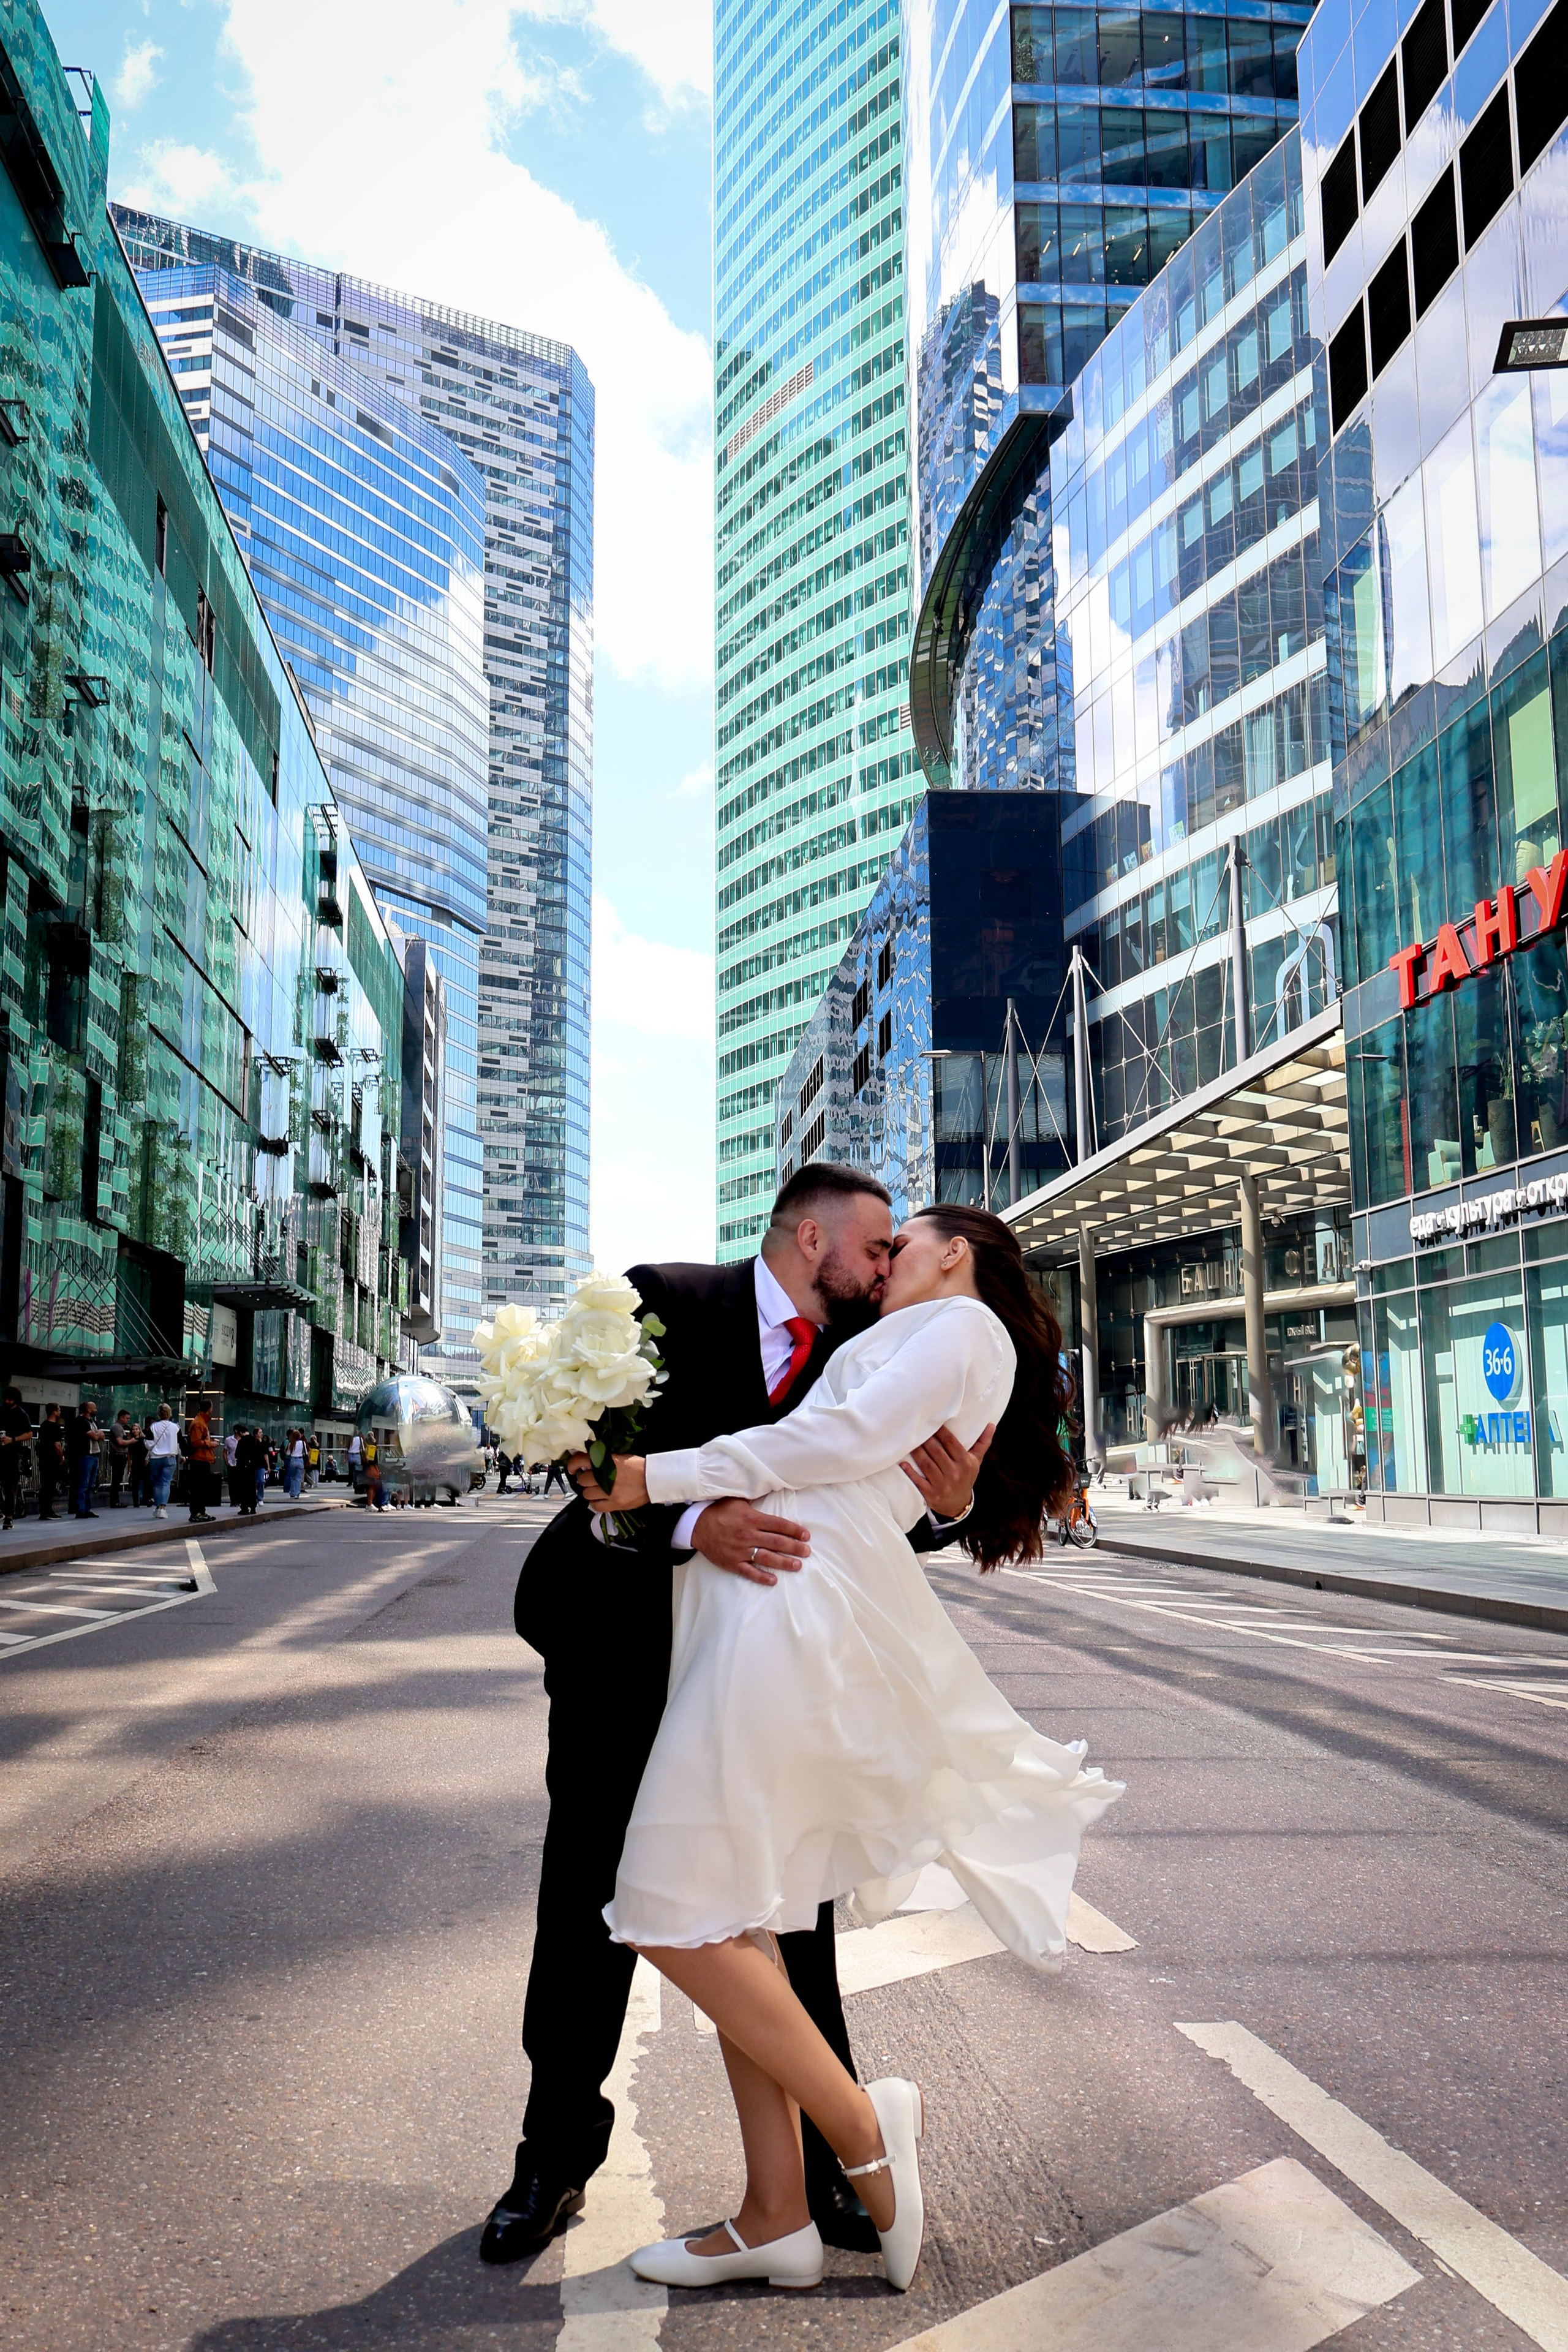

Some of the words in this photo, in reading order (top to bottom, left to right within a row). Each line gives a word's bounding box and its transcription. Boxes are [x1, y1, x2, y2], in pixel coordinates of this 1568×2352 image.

[1410, 1212, 1436, 1240] еда
[1444, 1188, 1516, 1234] культура
[1526, 1172, 1568, 1207] откр
